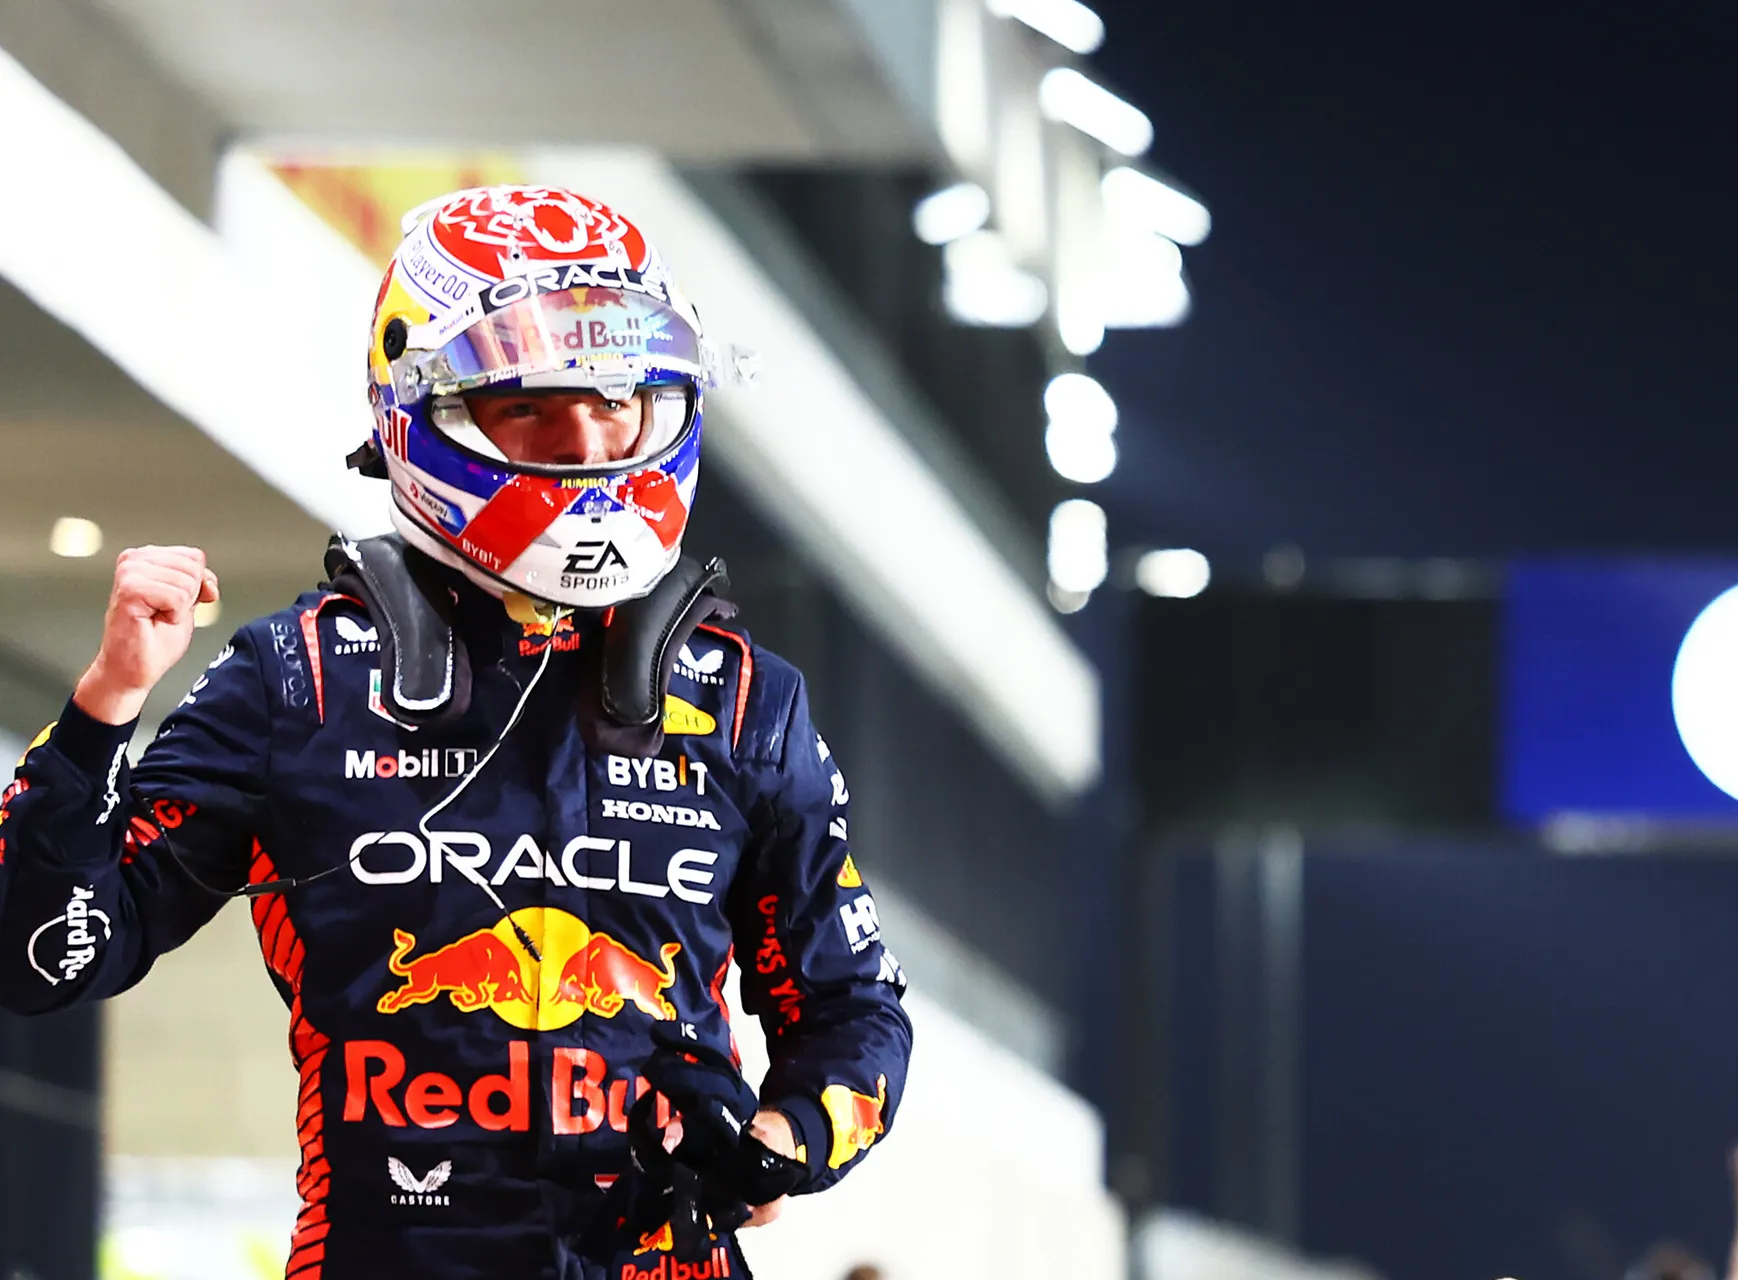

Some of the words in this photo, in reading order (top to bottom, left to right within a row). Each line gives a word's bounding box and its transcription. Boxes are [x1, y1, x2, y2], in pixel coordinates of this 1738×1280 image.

[489, 264, 667, 308] ORACLE
[562, 540, 629, 574] EA
[559, 572, 630, 591] SPORTS
[552, 632, 580, 652] Bull
[345, 748, 439, 779] Mobil
[607, 755, 708, 796] BYBIT
[601, 798, 722, 831] HONDA
[348, 830, 720, 906] ORACLE
[343, 1040, 530, 1132] Red
[552, 1046, 681, 1135] Bu
[390, 1194, 450, 1207] CASTORE
